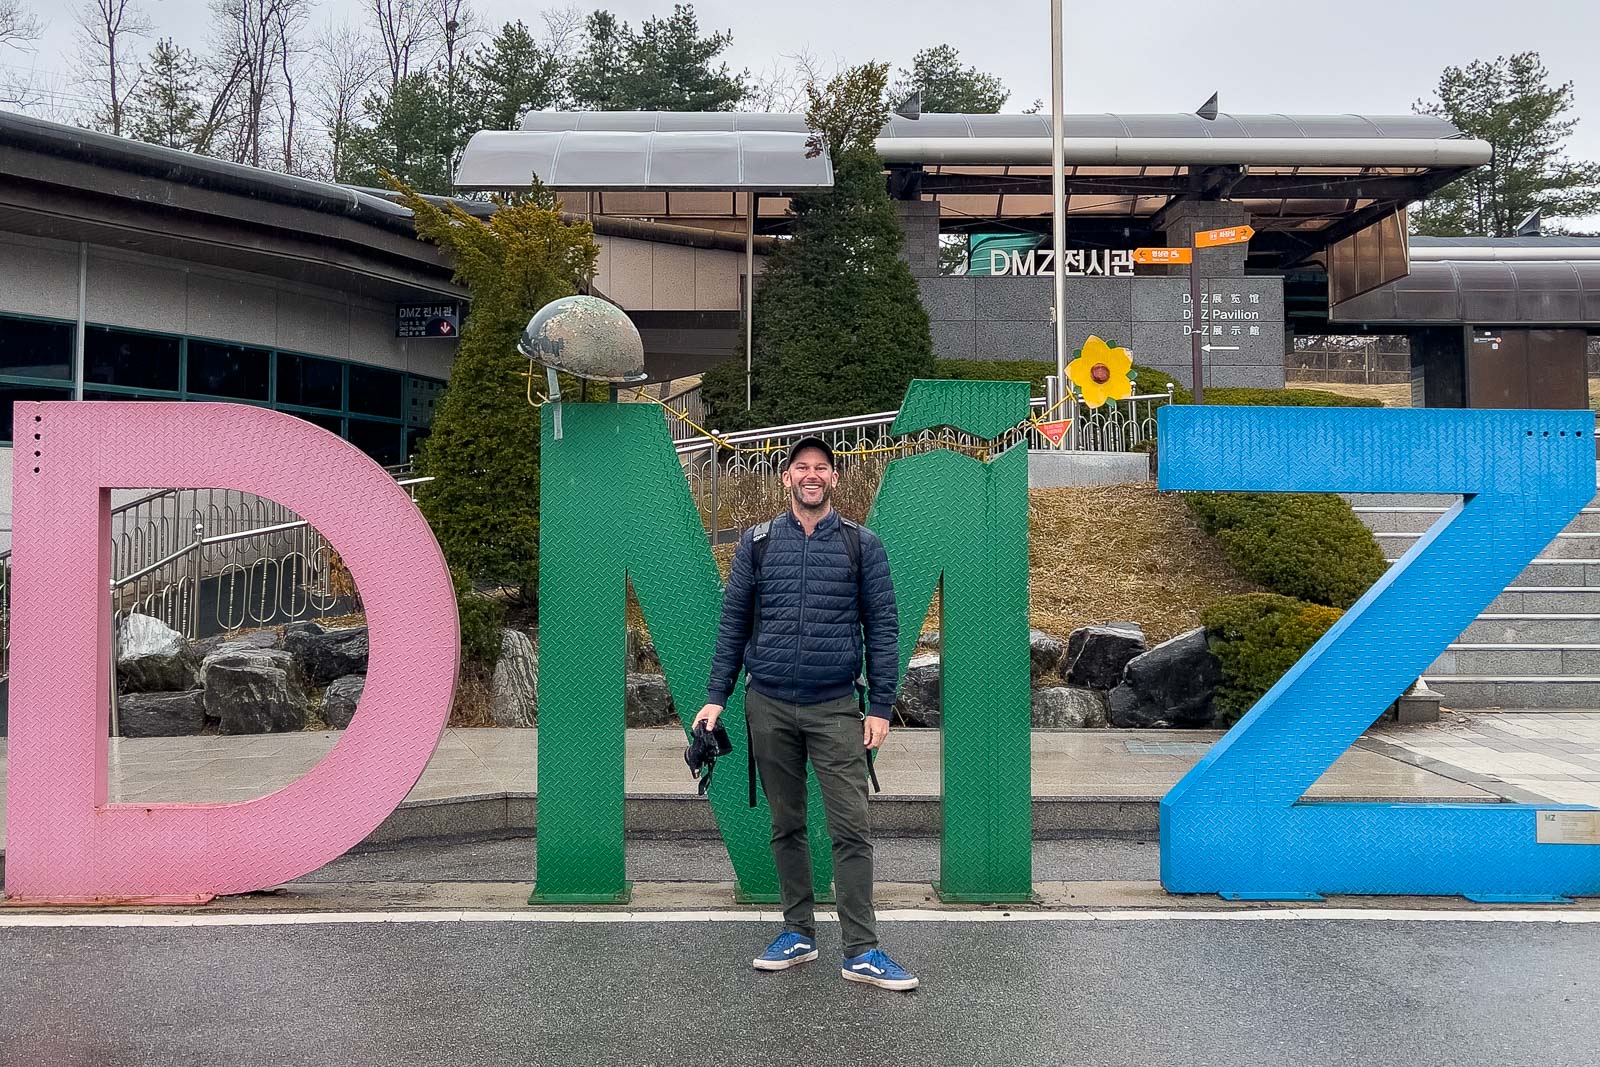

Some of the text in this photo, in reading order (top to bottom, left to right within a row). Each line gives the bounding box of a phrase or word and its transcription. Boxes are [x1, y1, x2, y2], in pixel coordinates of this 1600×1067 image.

[990, 249, 1135, 277] DMZ 전시관
[1182, 293, 1209, 304] DZ
[399, 306, 452, 318] DMZ 전시관
[1183, 309, 1259, 320] DZ Pavilion
[1183, 325, 1210, 336] DZ
[5, 379, 1600, 904] DMZ
